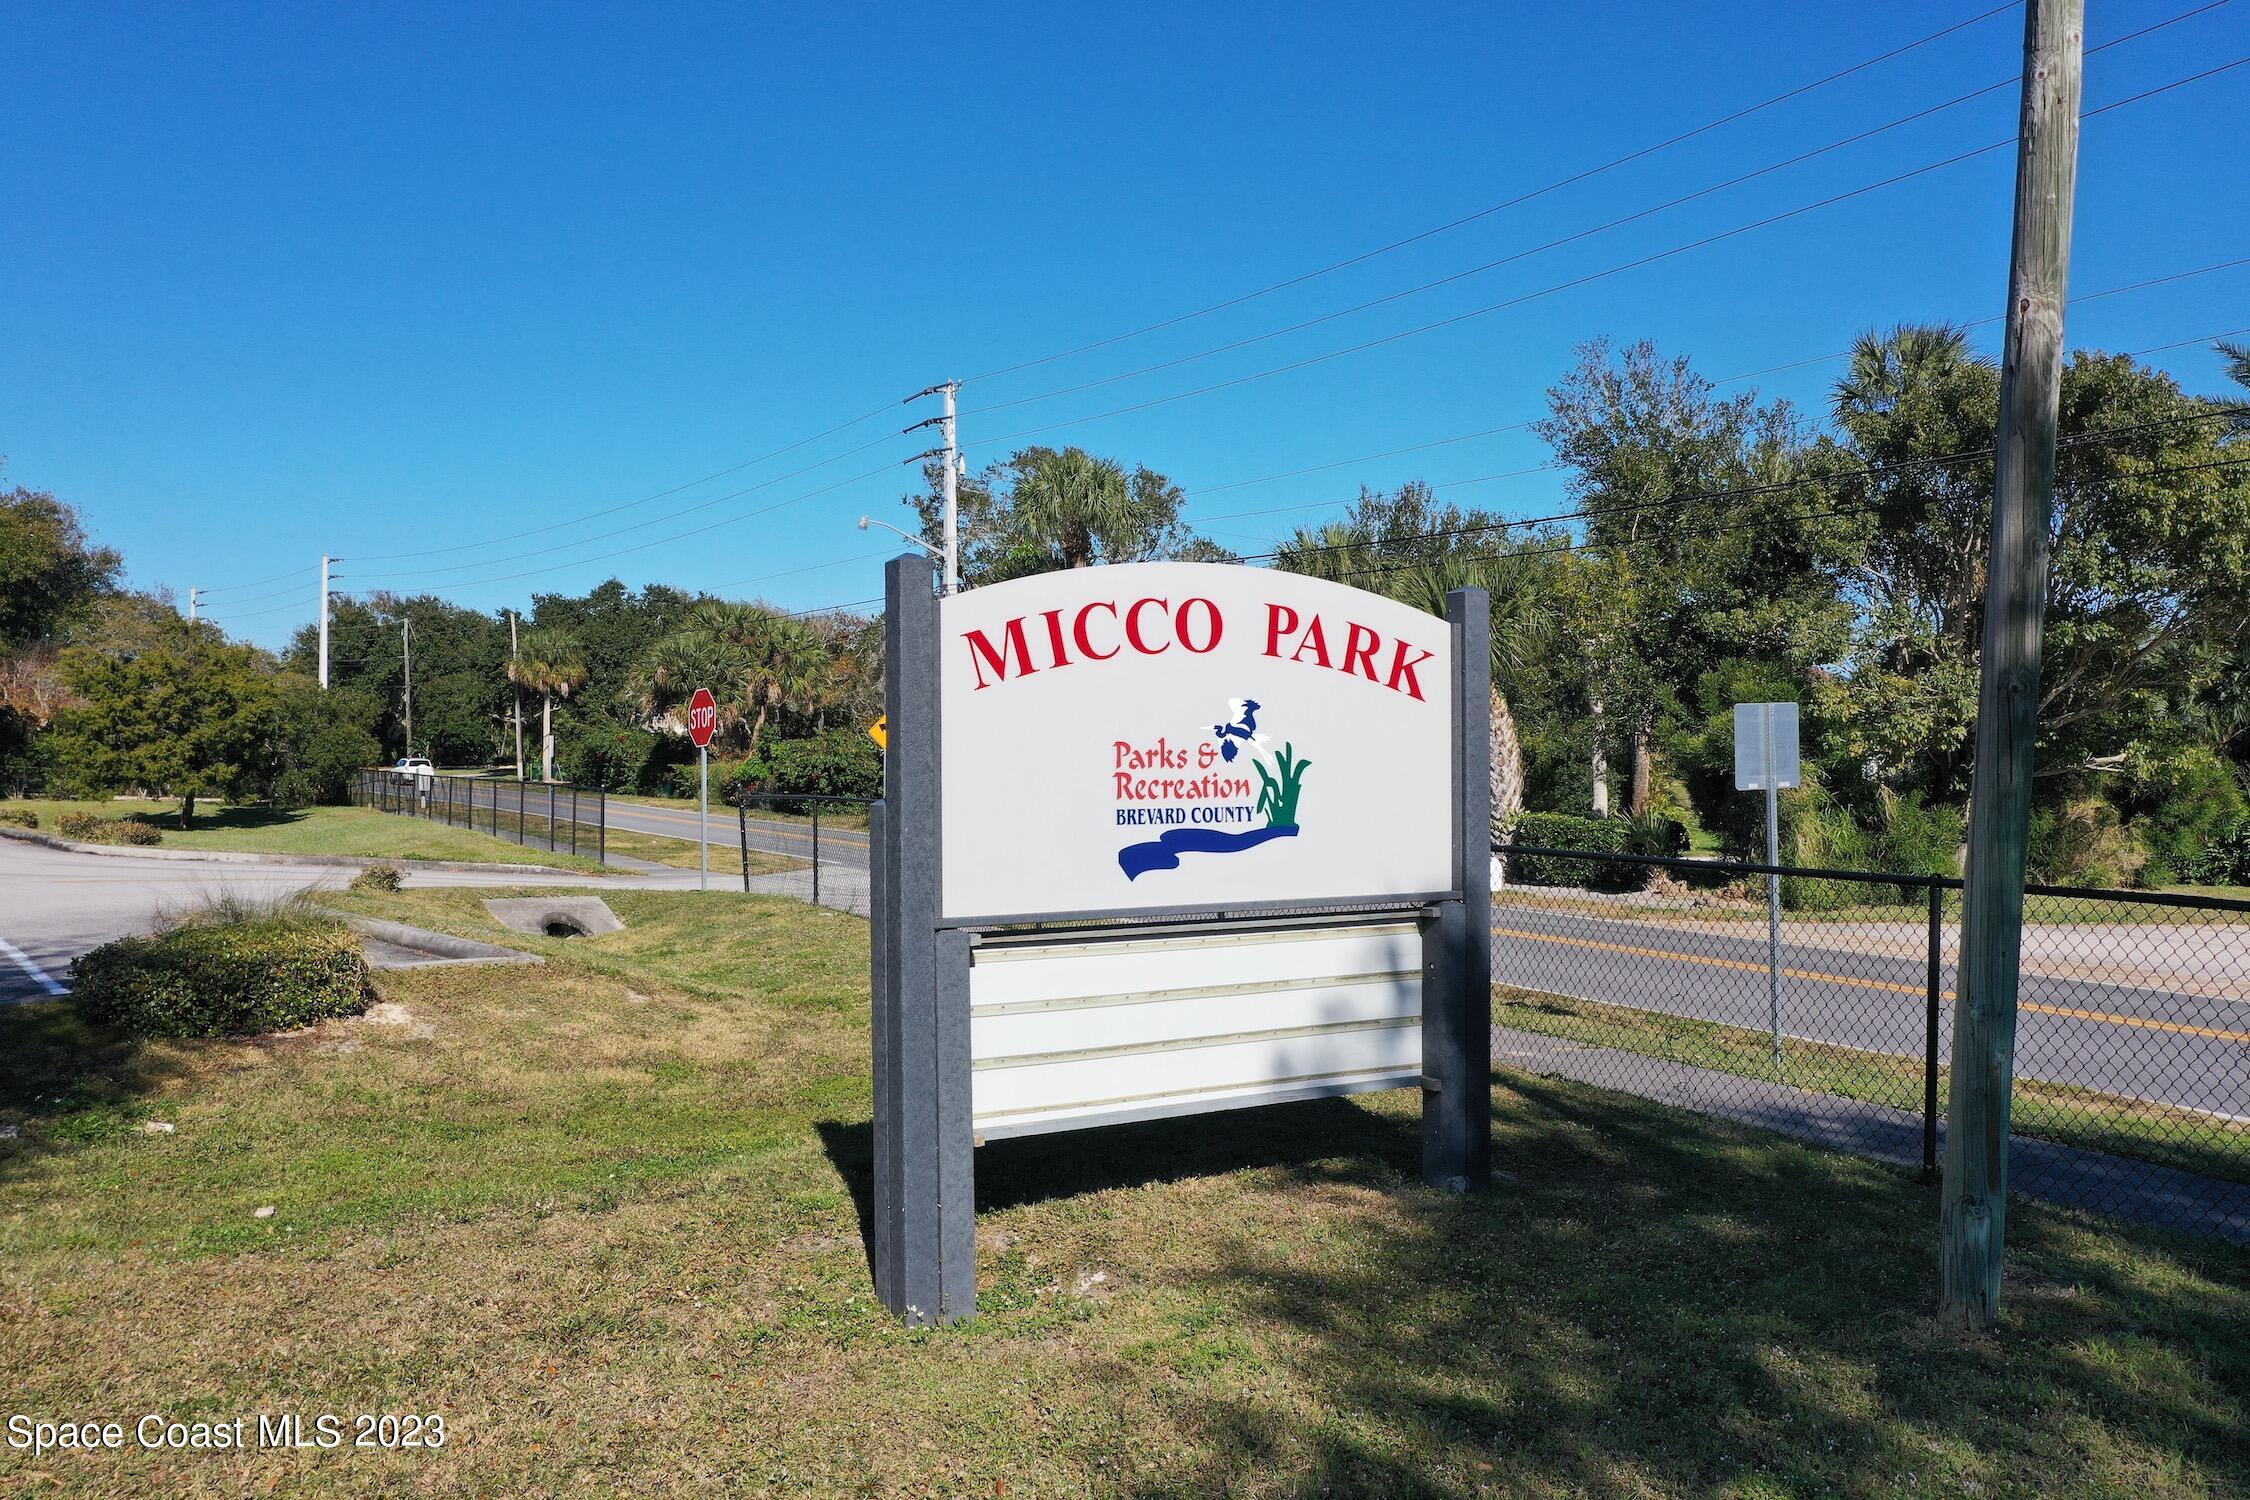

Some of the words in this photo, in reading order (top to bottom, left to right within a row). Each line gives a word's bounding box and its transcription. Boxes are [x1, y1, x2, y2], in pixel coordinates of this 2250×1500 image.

[960, 597, 1223, 691] MICCO
[1261, 603, 1435, 702] PARK
[691, 707, 713, 730] STOP
[1113, 738, 1188, 770] Parks
[1198, 743, 1218, 769] &
[1112, 772, 1251, 800] Recreation
[1116, 808, 1186, 825] BREVARD
[1191, 806, 1254, 824] COUNTY
